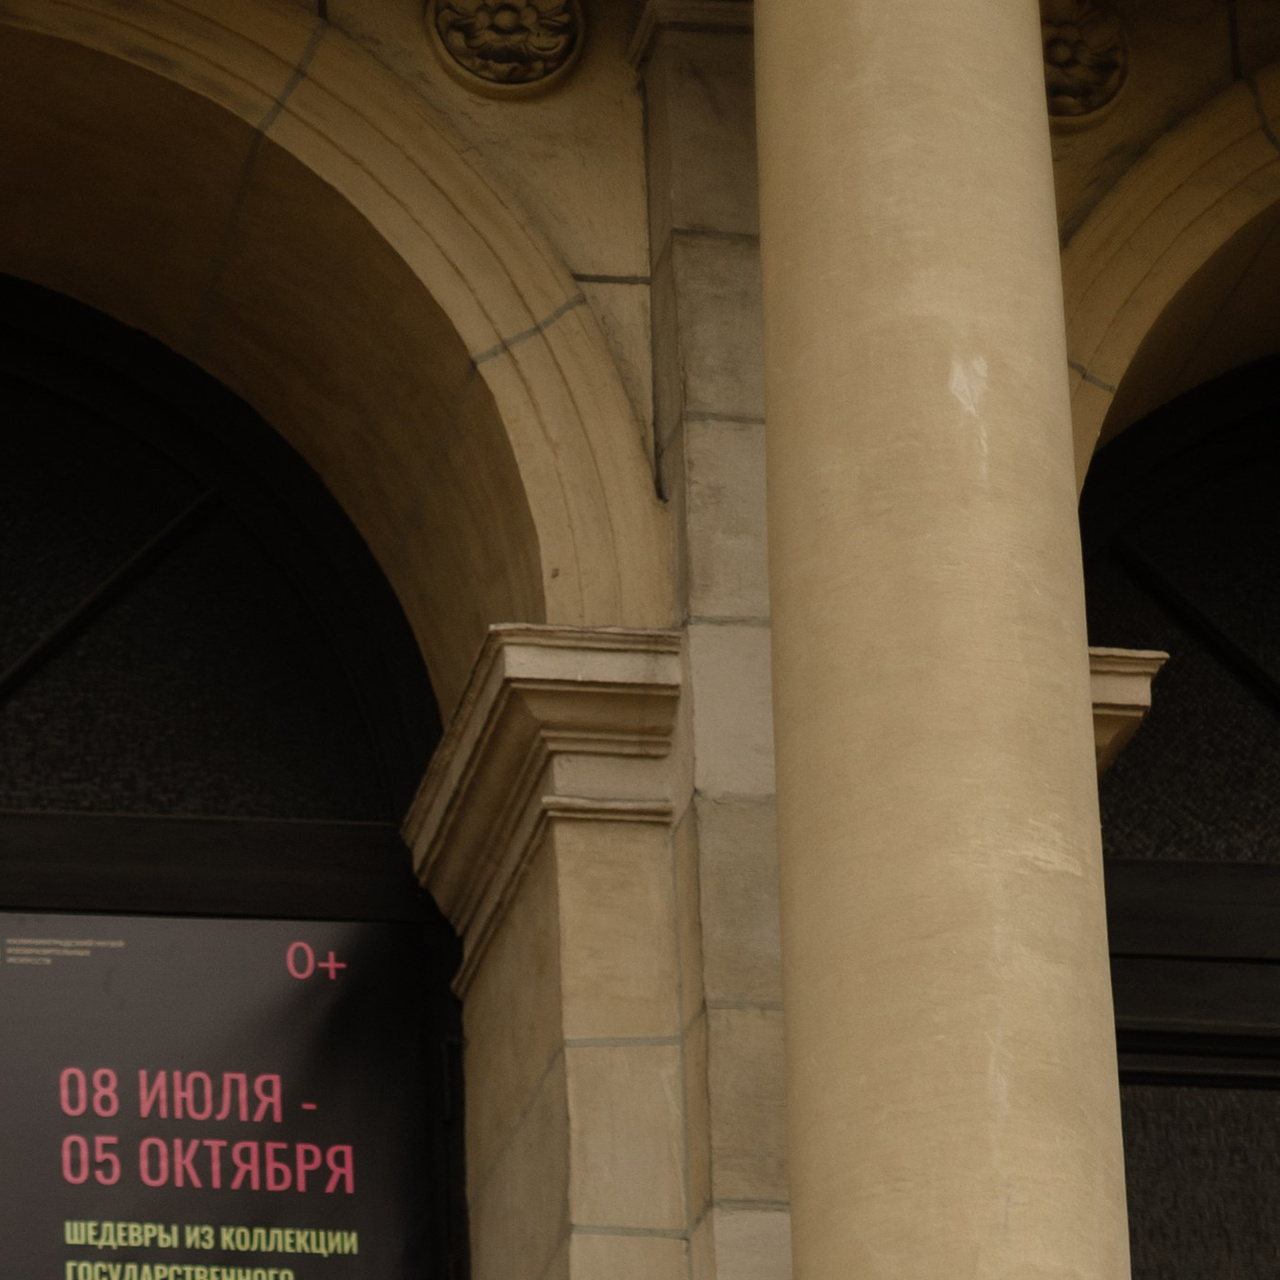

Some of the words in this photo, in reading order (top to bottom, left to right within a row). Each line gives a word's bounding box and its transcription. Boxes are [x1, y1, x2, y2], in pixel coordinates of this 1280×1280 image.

[286, 941, 347, 981] 0+
[59, 1067, 120, 1118] 08
[138, 1069, 284, 1123] ИЮЛЯ
[61, 1134, 121, 1186] 05
[138, 1137, 356, 1194] ОКТЯБРЯ
[64, 1220, 180, 1250] ШЕДЕВРЫ
[184, 1224, 216, 1251] ИЗ
[221, 1225, 359, 1257] КОЛЛЕКЦИИ
